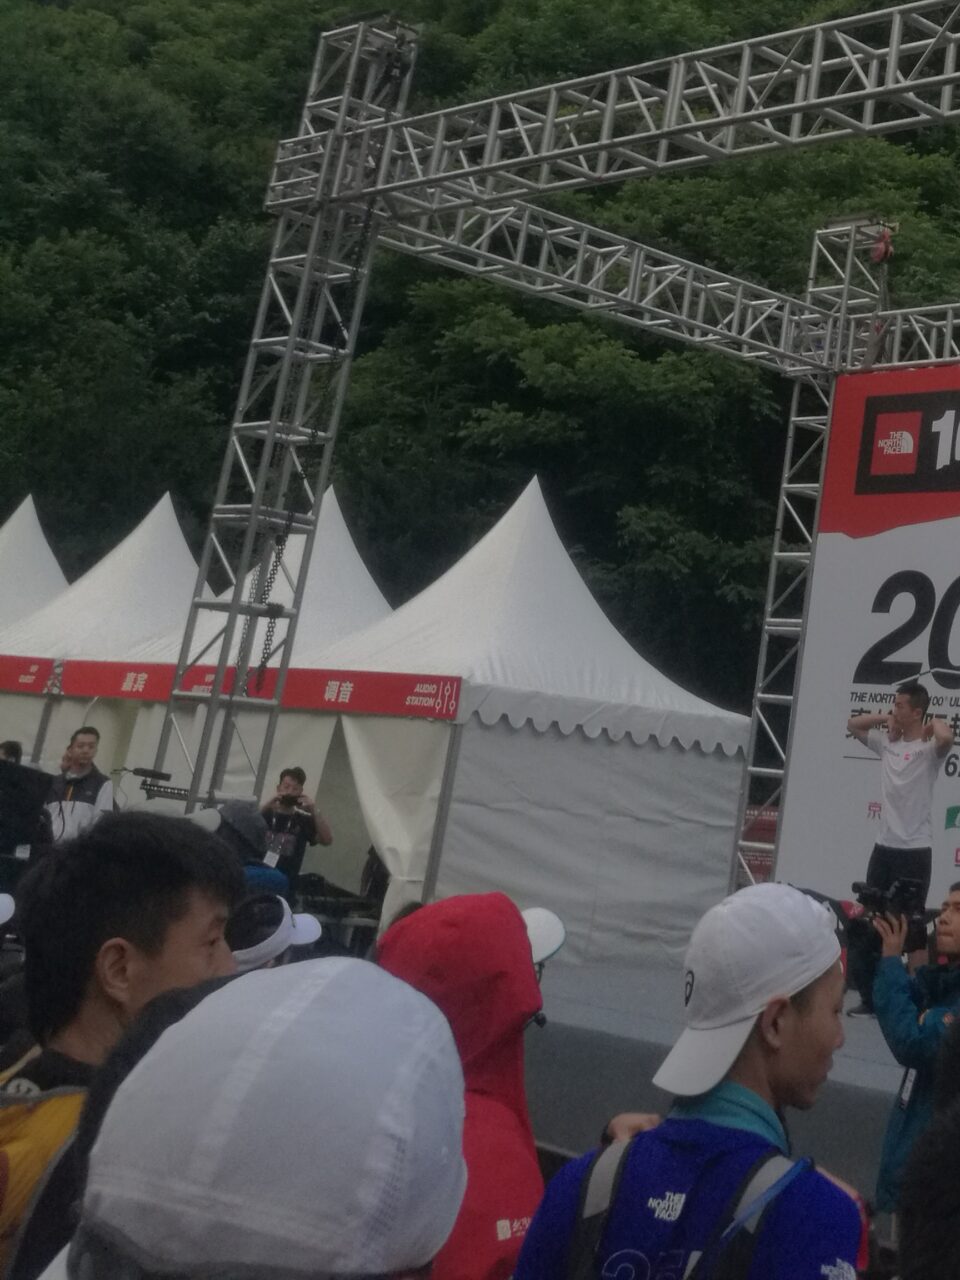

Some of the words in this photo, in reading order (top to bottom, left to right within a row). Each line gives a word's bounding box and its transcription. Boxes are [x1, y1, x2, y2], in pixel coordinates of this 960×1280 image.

[890, 431, 904, 439] THE
[878, 438, 903, 448] NORTH
[884, 446, 903, 455] FACE
[324, 680, 354, 704] 调音
[414, 683, 438, 694] AUDIO
[405, 696, 435, 707] STATION
[850, 692, 867, 702] THE
